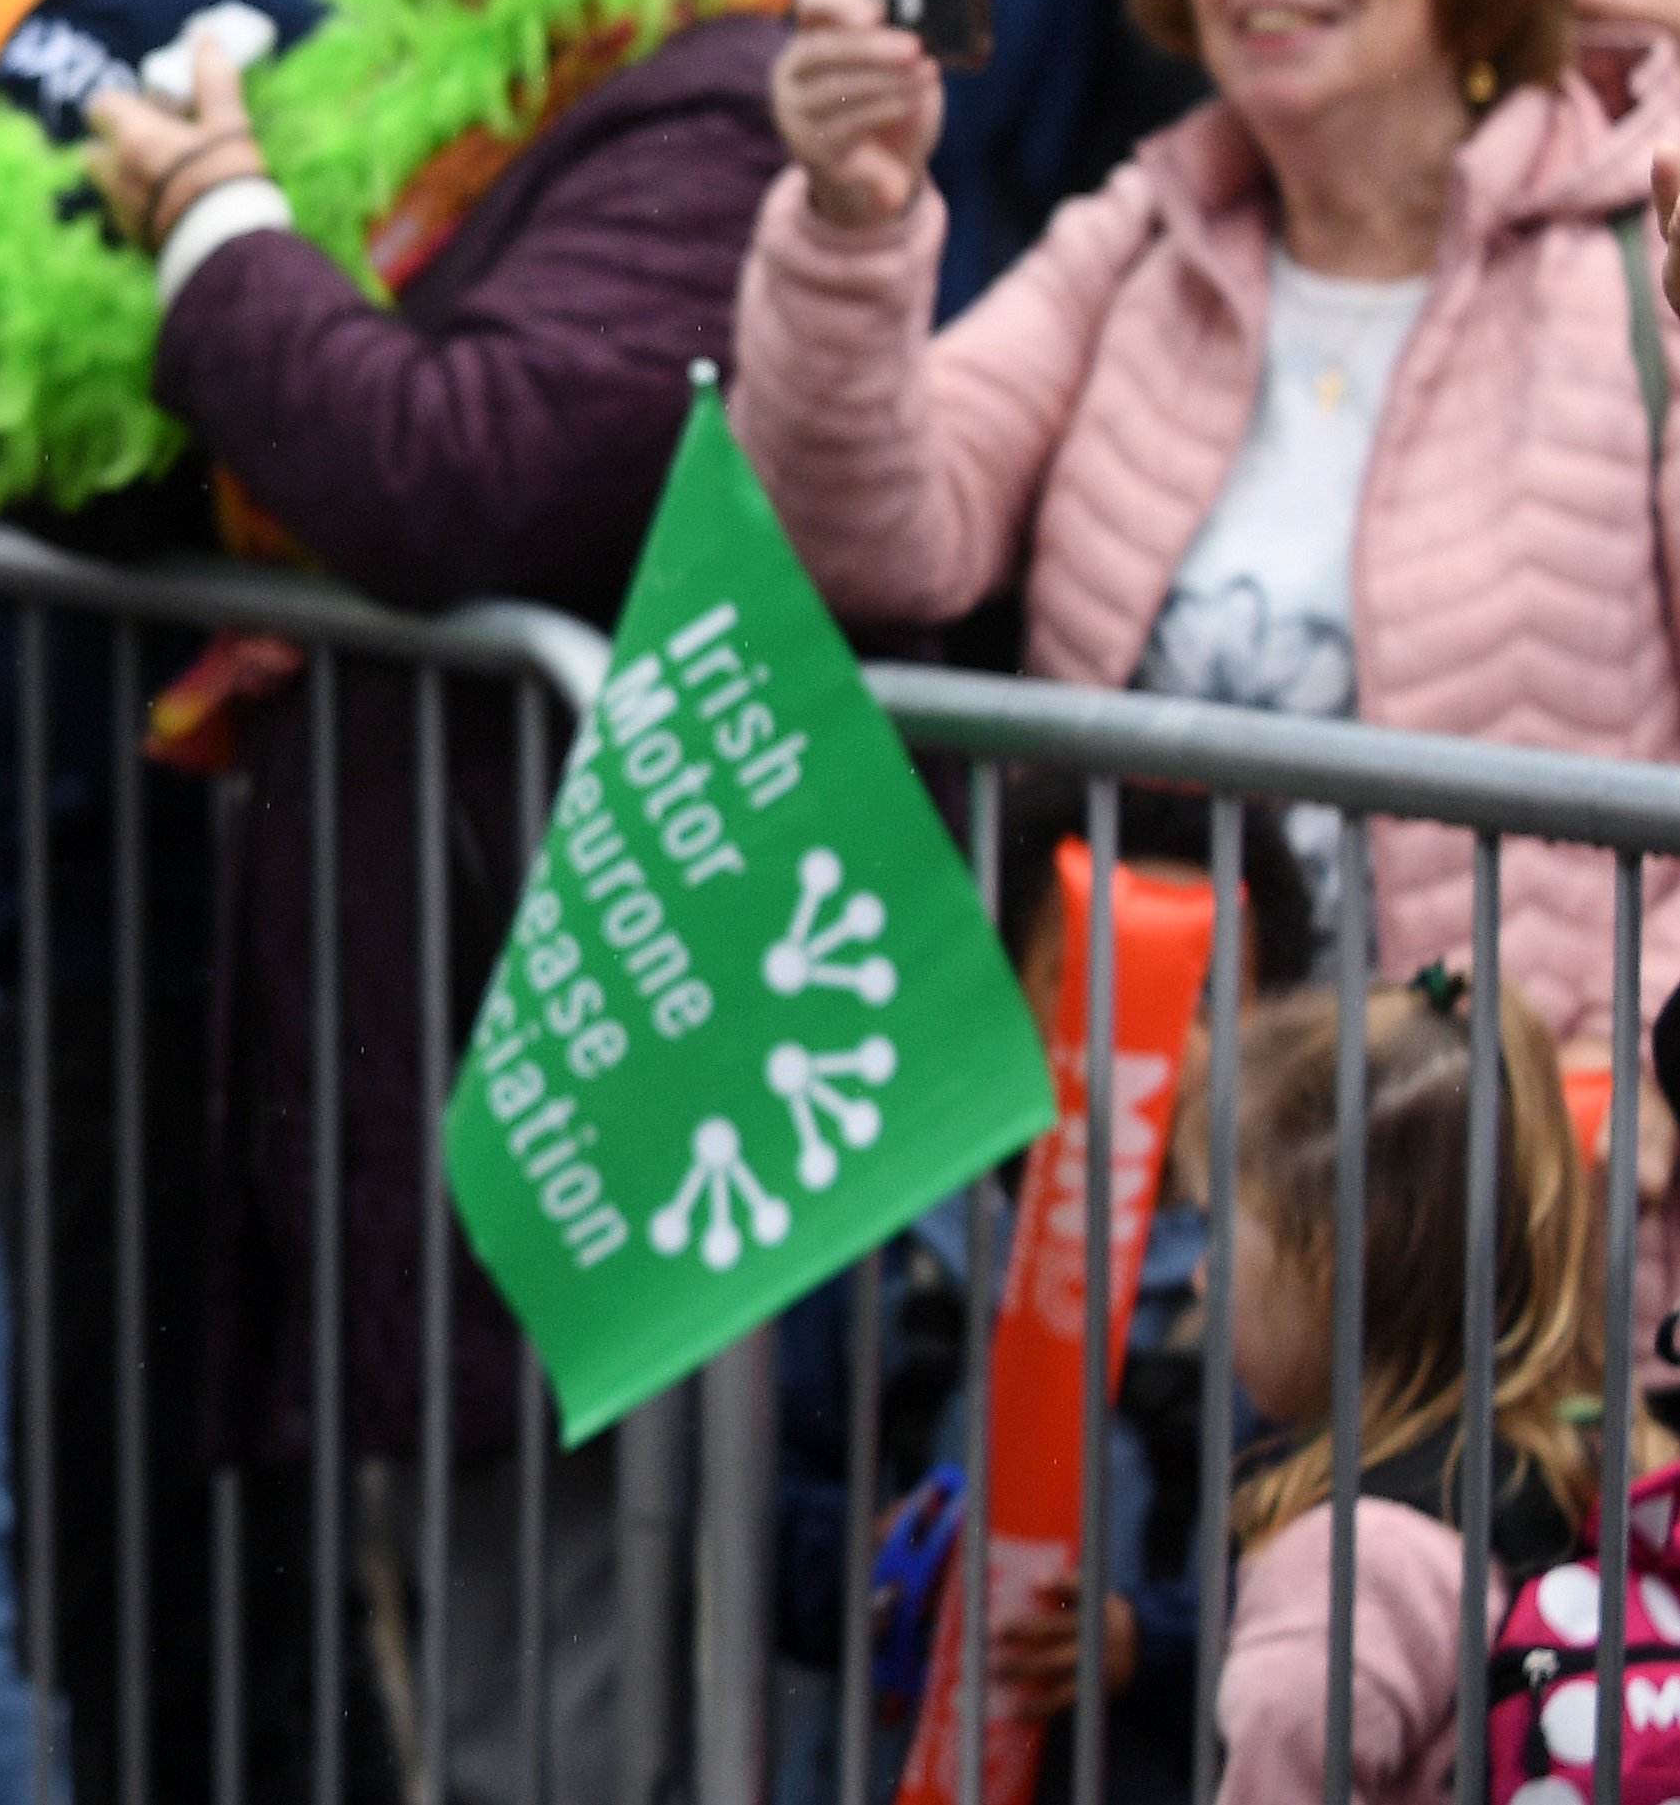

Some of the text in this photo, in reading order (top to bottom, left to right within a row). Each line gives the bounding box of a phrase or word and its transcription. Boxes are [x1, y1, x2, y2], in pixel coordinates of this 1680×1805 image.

[601, 652, 746, 888] Motor
[667, 602, 810, 809] Irish
[557, 724, 715, 1040] eurone
